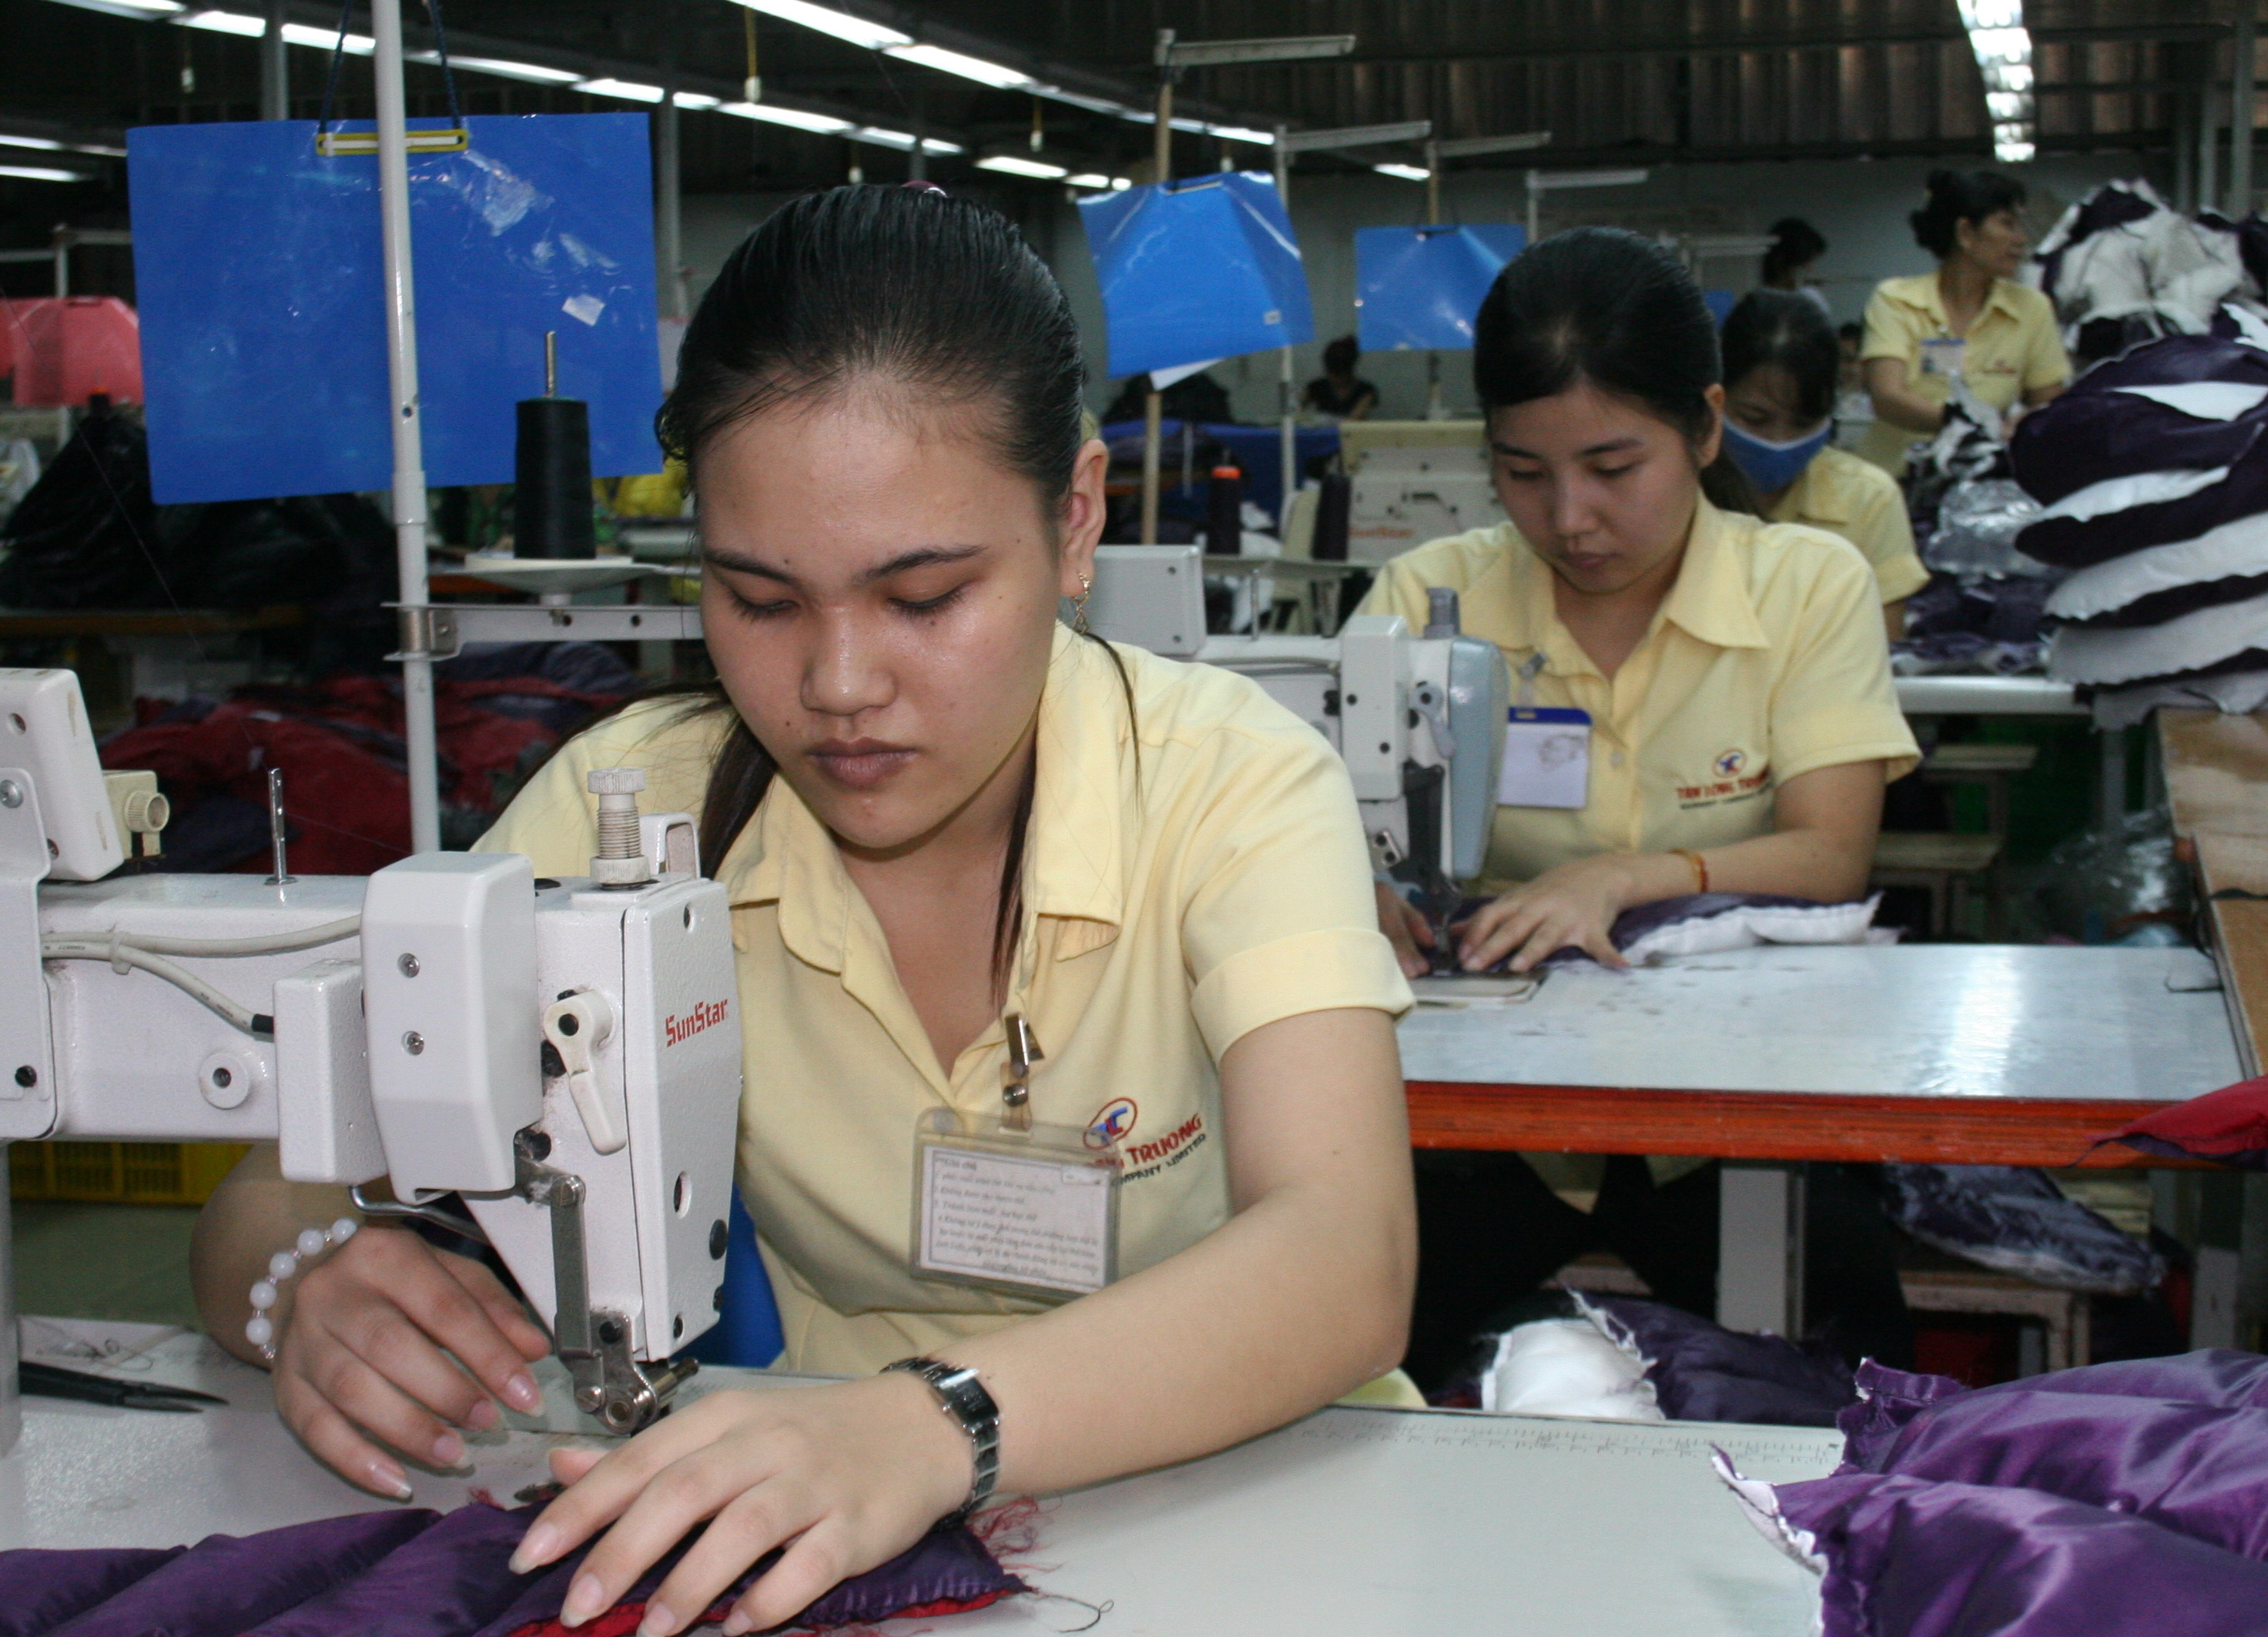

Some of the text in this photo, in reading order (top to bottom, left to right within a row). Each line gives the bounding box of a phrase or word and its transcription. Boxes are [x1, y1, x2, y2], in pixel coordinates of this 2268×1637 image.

[665, 999, 728, 1047] SunStar
[1125, 1113, 1202, 1165] TRUONG
[1110, 1164, 1161, 1187] MPANY
